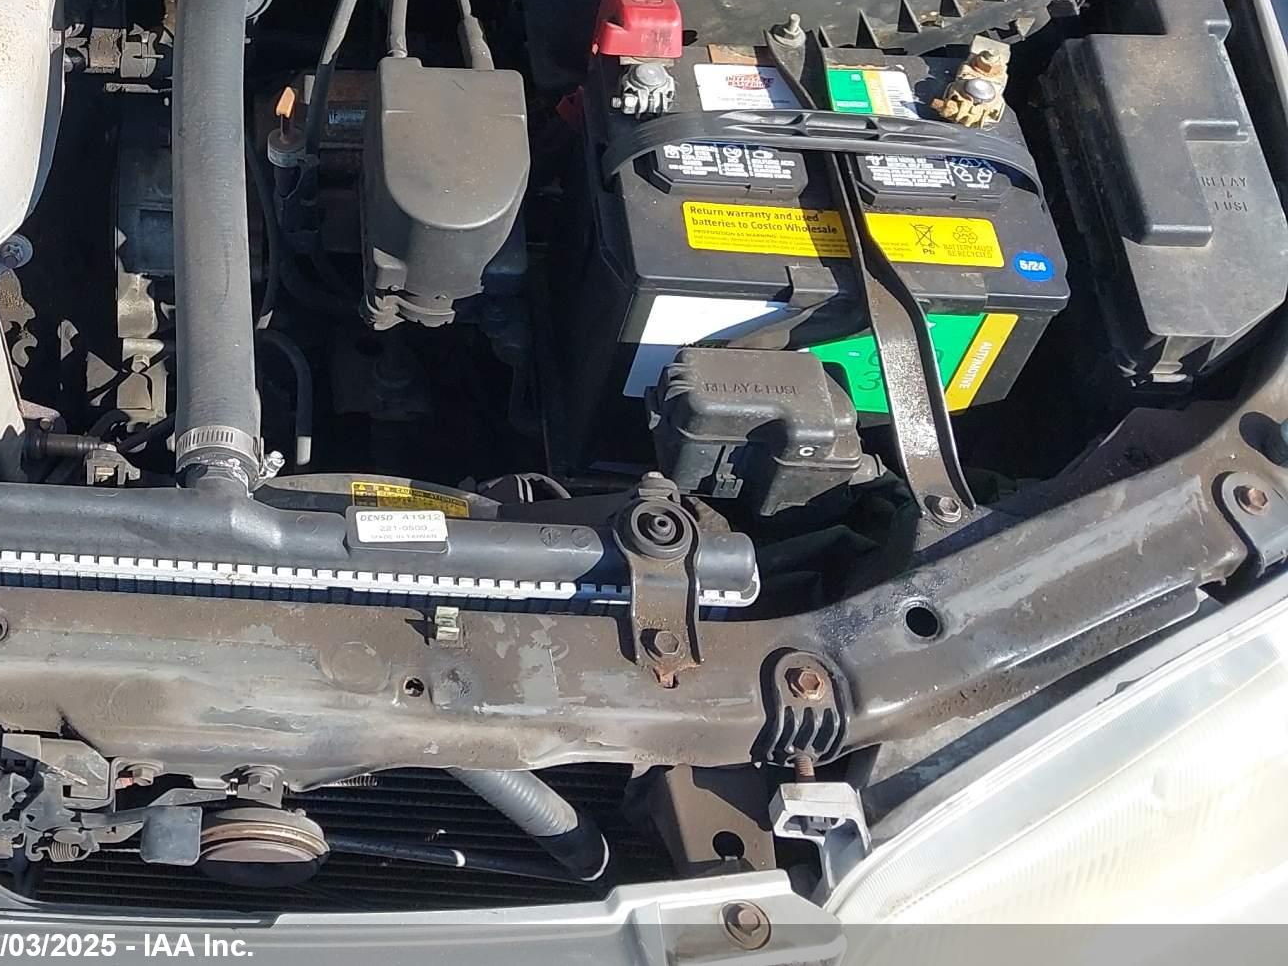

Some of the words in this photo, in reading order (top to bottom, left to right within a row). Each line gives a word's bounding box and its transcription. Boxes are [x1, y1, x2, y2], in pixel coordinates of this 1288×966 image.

[1201, 176, 1248, 187] RELAY
[690, 205, 723, 216] Return
[726, 208, 771, 220] warranty
[774, 211, 792, 221] and
[795, 213, 819, 222] used
[692, 217, 736, 227] batteries
[738, 221, 748, 229] to
[751, 221, 782, 231] Costco
[785, 223, 837, 234] Wholesale
[922, 248, 935, 256] Pb
[1019, 259, 1047, 272] 5/24
[959, 340, 993, 390] AUTOMOTIVE
[360, 514, 393, 522] DENSO
